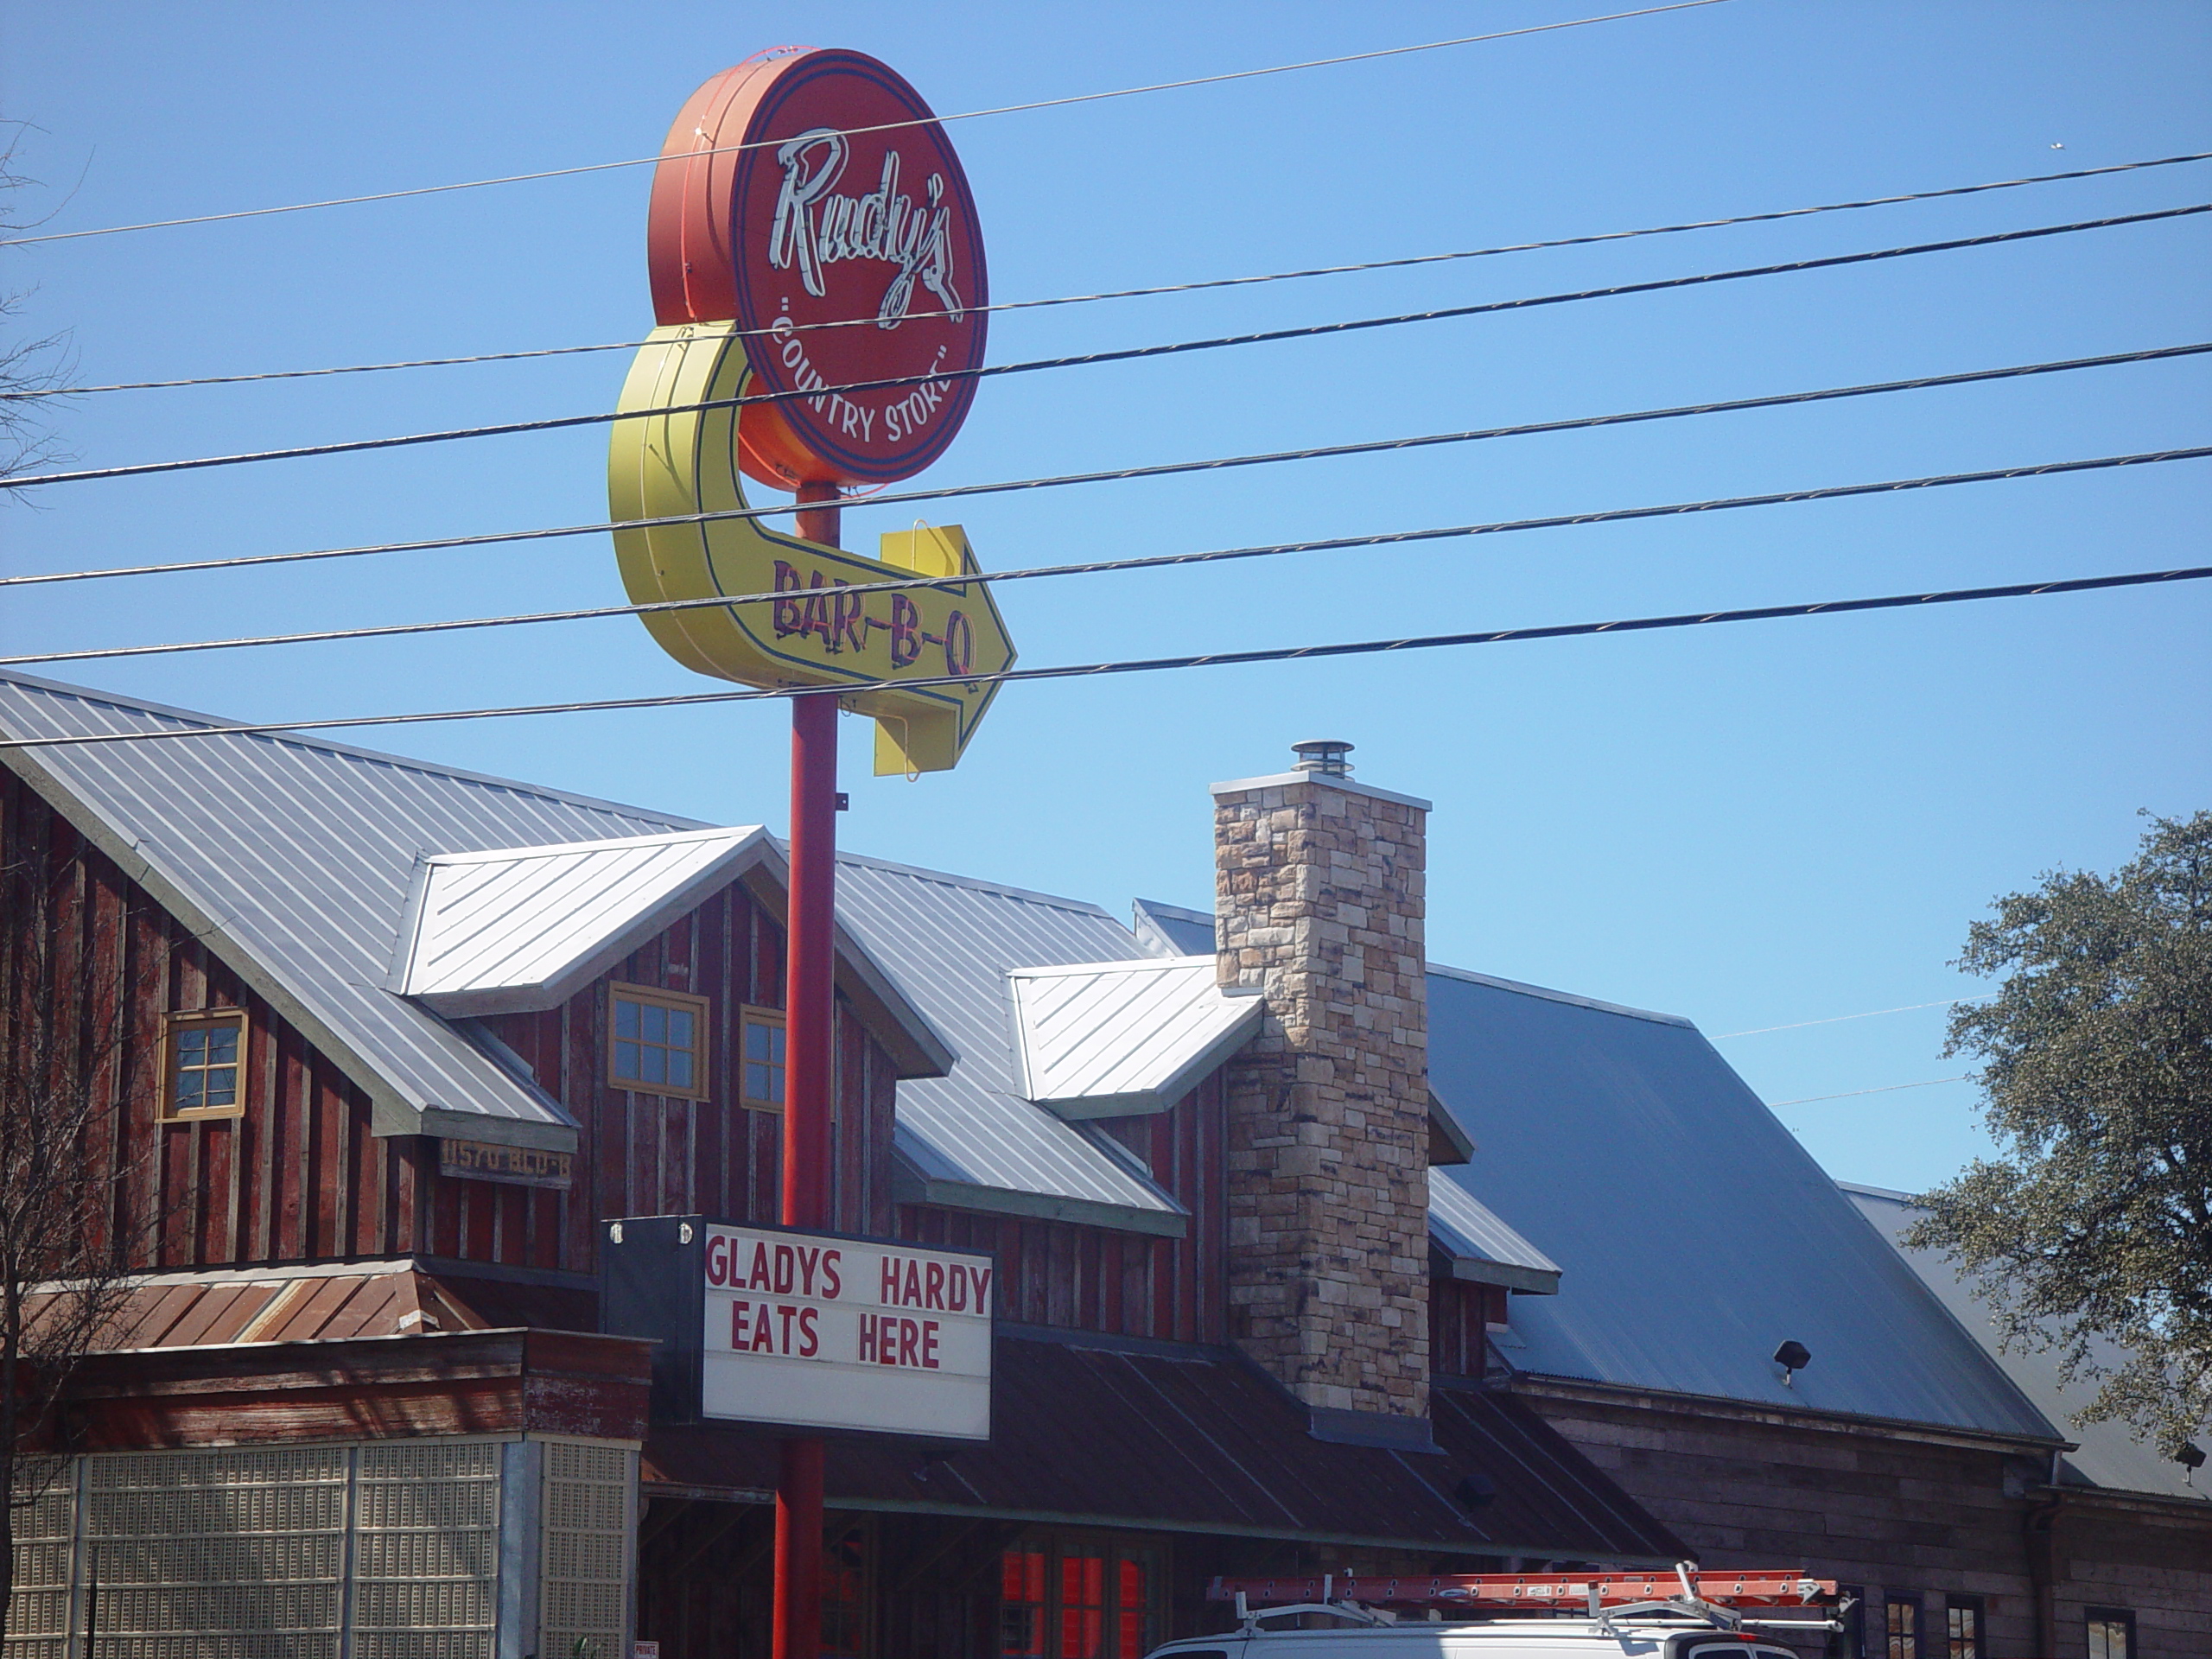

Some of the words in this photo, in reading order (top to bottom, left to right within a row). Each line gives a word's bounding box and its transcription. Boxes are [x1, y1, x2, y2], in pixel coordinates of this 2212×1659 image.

[769, 127, 963, 329] Rudy's
[705, 1235, 842, 1300] GLADYS
[880, 1255, 992, 1315] HARDY
[731, 1300, 819, 1357] EATS
[858, 1312, 940, 1370] HERE
